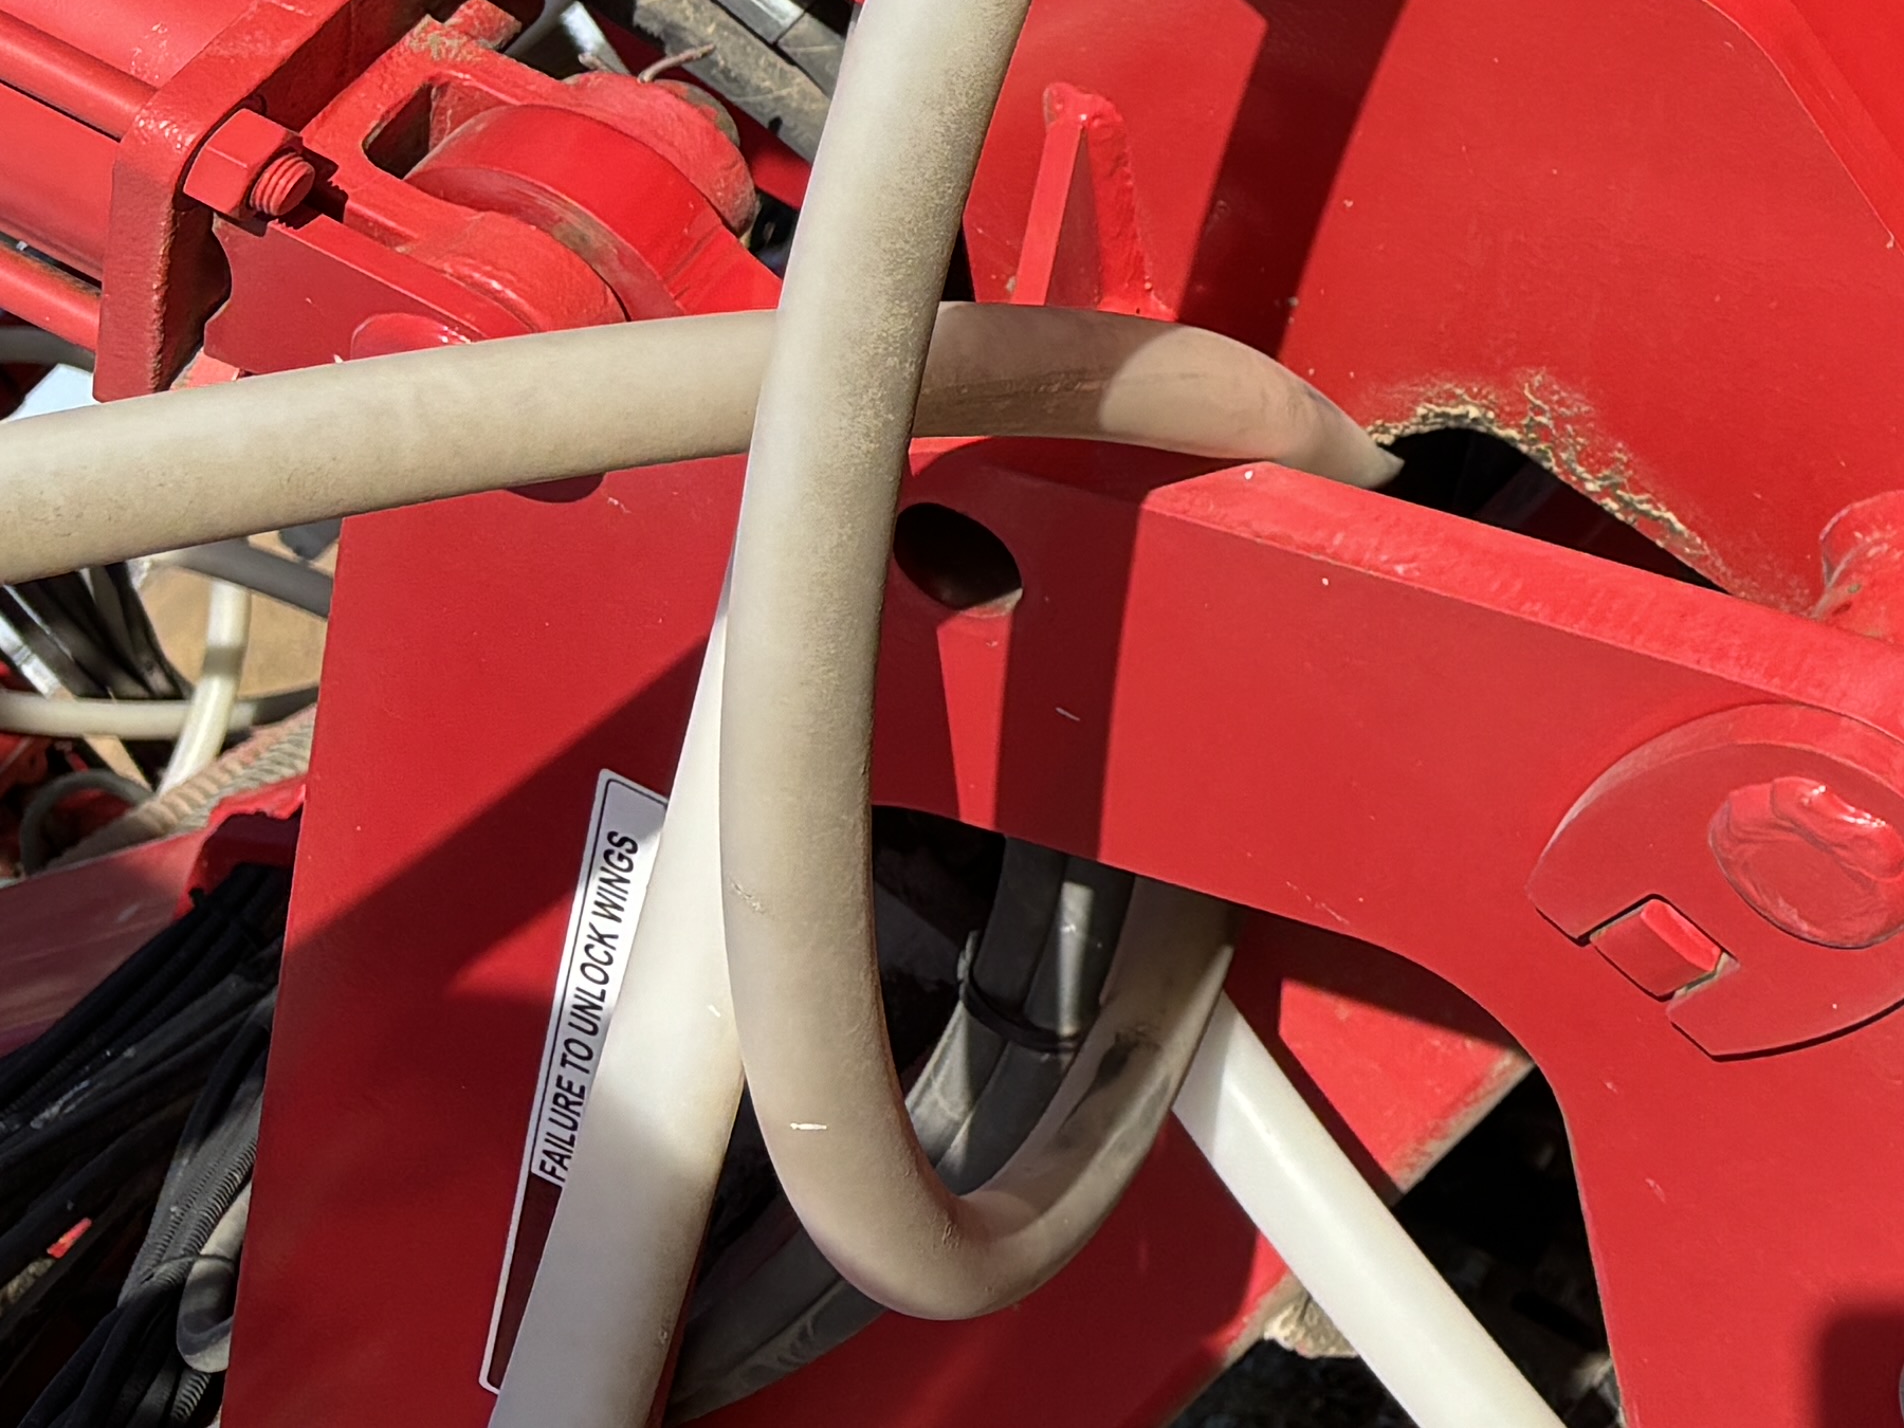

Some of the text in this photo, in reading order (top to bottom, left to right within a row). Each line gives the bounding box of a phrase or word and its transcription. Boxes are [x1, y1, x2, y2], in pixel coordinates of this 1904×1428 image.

[538, 829, 640, 1183] FAILURE TO UNLOCK WINGS
